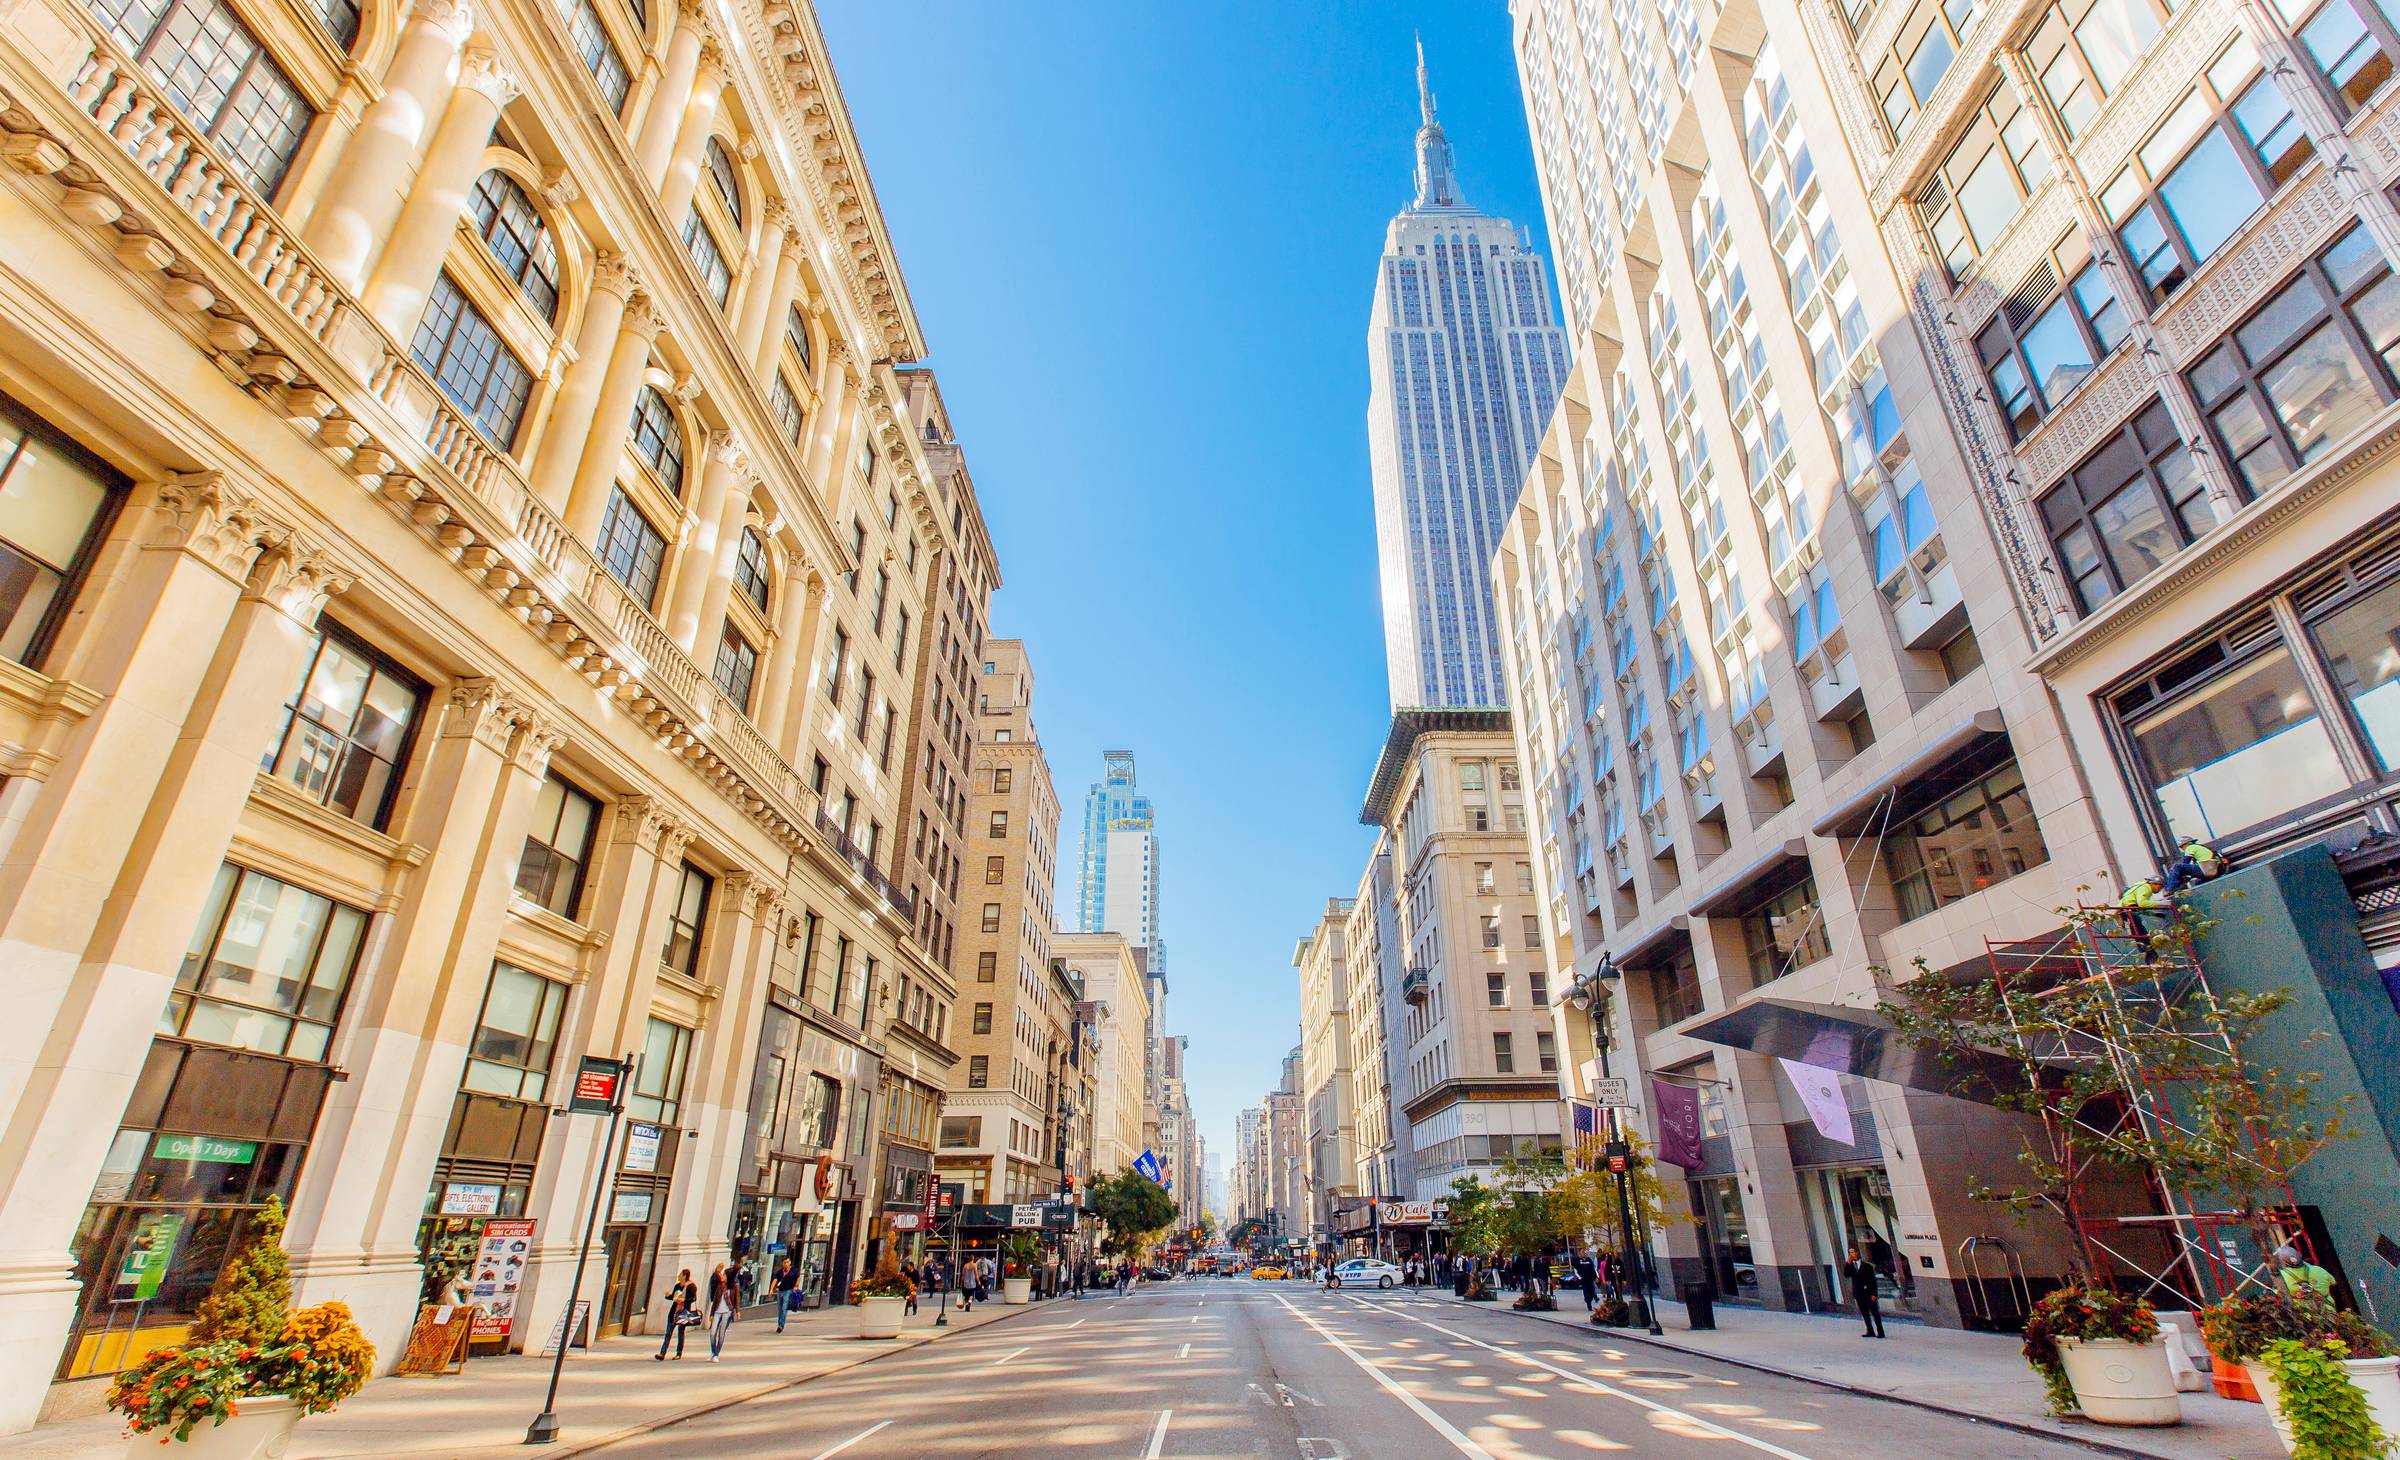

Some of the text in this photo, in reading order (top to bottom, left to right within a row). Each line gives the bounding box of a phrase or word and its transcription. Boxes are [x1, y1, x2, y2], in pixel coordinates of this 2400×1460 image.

[171, 1141, 240, 1159] Open 7 Days
[462, 1194, 496, 1204] ELECTRONICS
[467, 1204, 490, 1213] GALLERY
[1405, 1203, 1428, 1215] Café
[471, 1326, 502, 1335] PHONES
